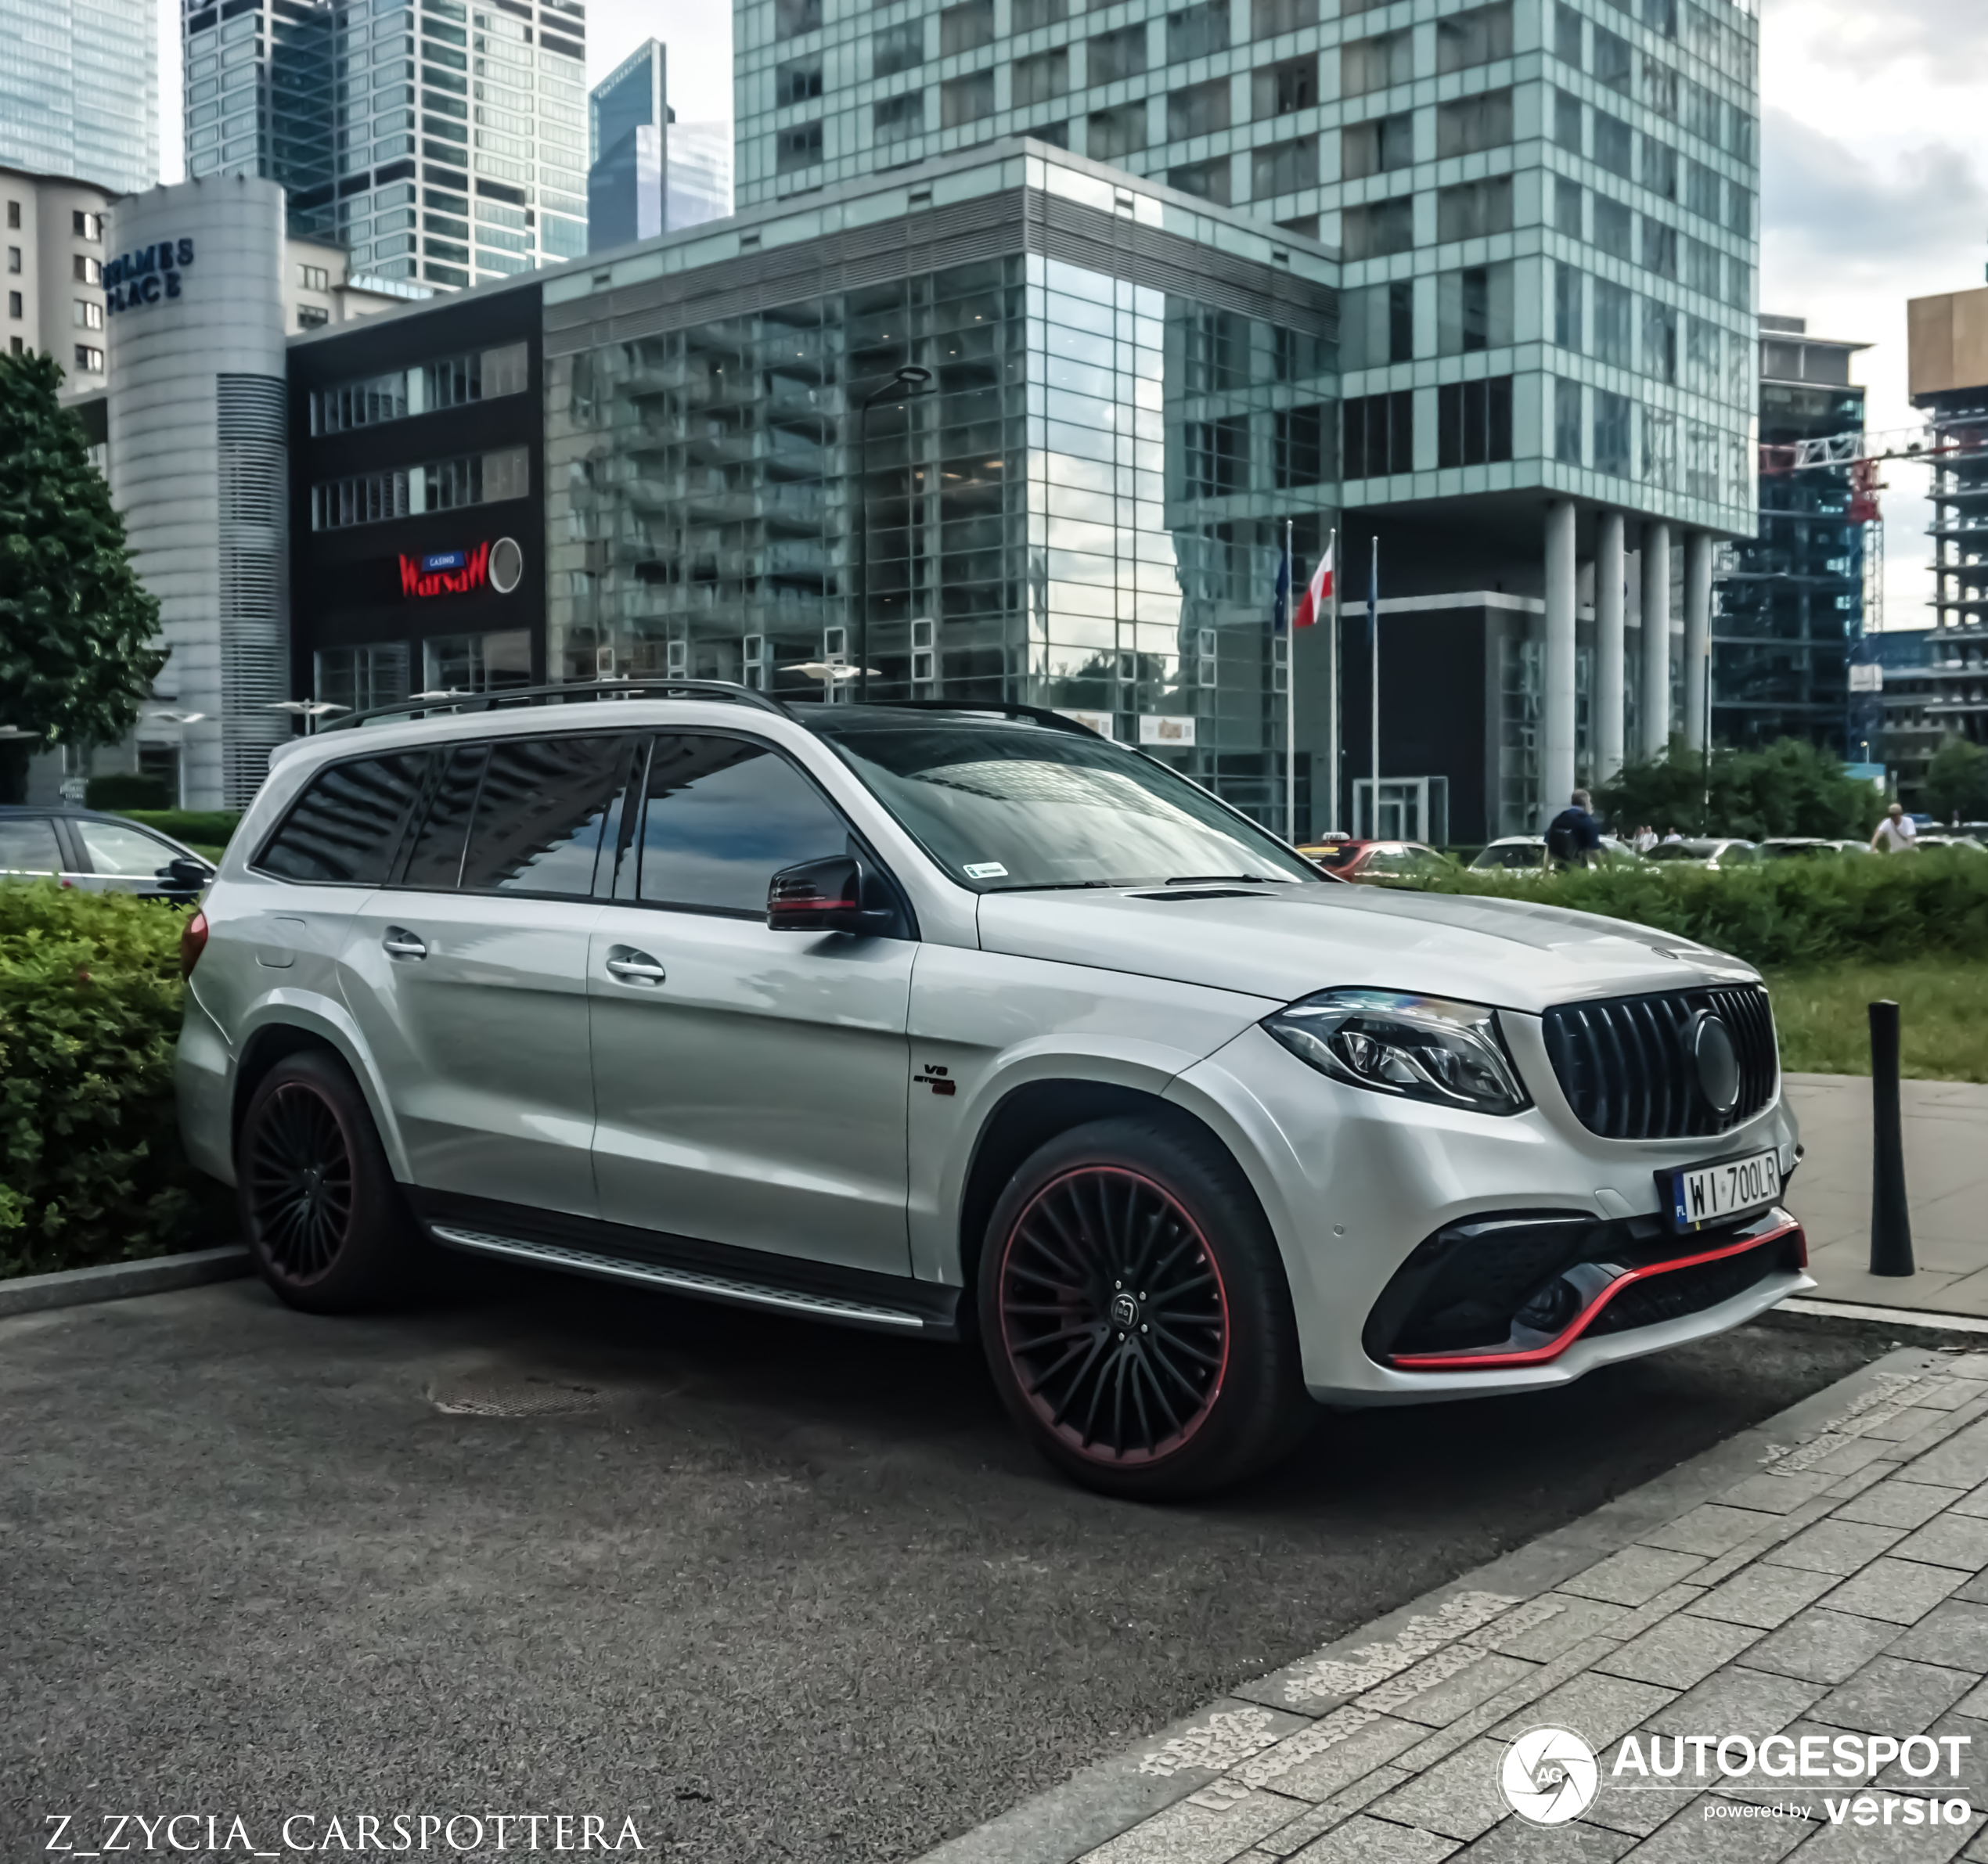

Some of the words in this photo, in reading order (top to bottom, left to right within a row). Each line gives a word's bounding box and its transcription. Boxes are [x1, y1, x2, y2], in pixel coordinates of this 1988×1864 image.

[429, 556, 455, 567] CASINO
[924, 1064, 948, 1076] V8
[1690, 1172, 1717, 1217] WI
[1727, 1156, 1777, 1207] 700LR
[1676, 1205, 1687, 1218] PL
